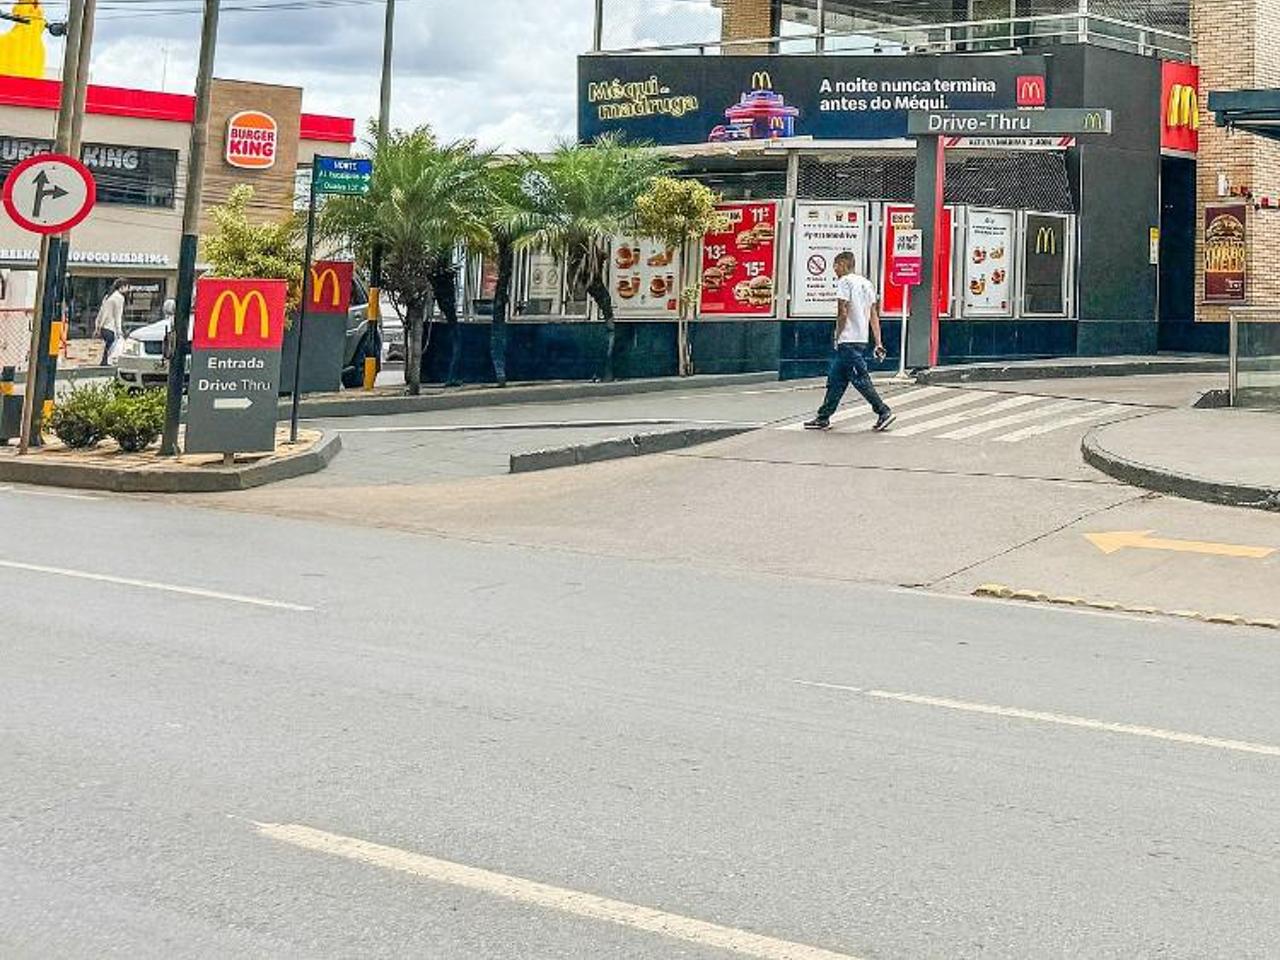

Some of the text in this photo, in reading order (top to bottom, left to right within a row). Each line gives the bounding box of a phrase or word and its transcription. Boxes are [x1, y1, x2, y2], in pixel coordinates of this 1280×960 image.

[819, 77, 996, 94] A noite nunca termina
[599, 95, 699, 120] madruga
[819, 94, 949, 111] antes do Méqui.
[928, 114, 1031, 131] Drive-Thru
[230, 127, 275, 142] BURGER
[229, 140, 274, 157] KING
[83, 147, 139, 170] KING
[207, 356, 265, 370] Entrada
[198, 378, 272, 392] Drive Thru
